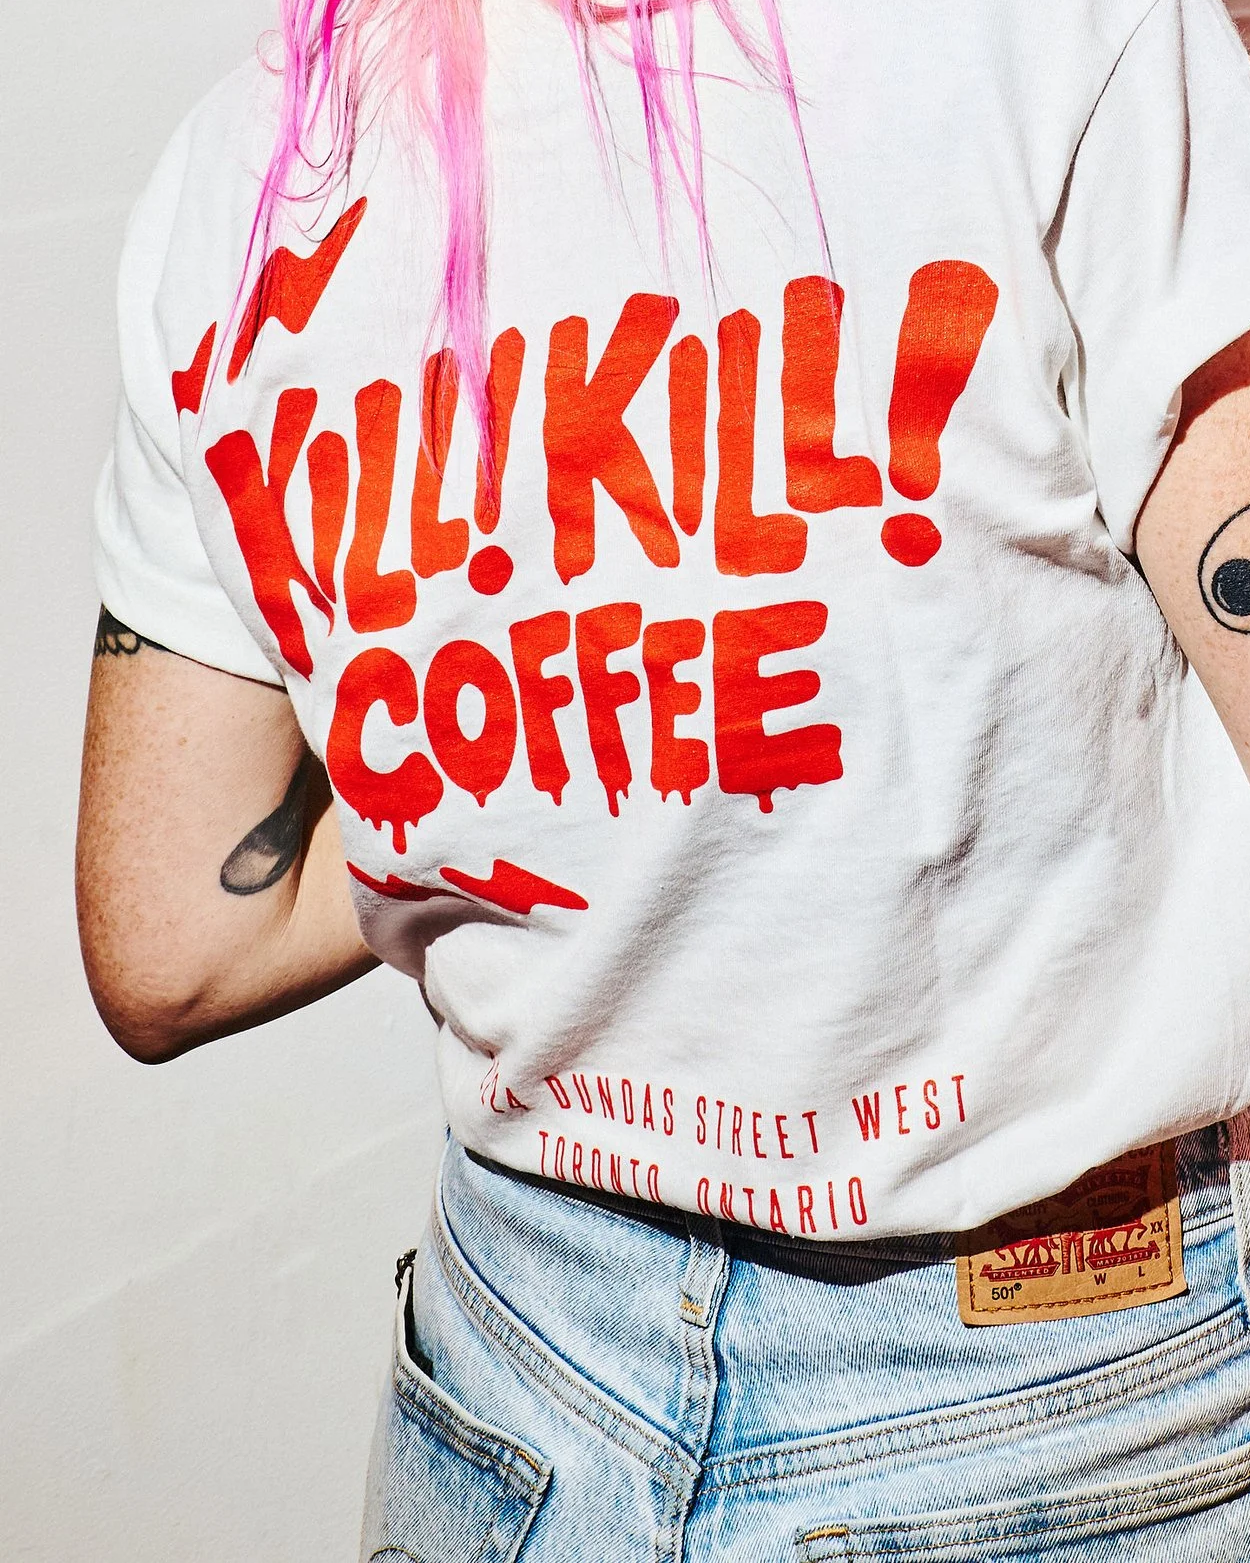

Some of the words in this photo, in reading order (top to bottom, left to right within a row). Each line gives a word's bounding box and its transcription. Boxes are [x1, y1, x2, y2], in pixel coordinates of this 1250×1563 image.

[205, 326, 525, 681] KILL!
[543, 259, 1000, 586] KILL!
[325, 599, 845, 856] COFFEE
[544, 1073, 674, 1136] DUNDAS
[696, 1095, 819, 1159] STREET
[851, 1074, 966, 1142] WEST
[538, 1130, 664, 1203] TORONTO
[696, 1176, 868, 1234] ONTARIO
[1149, 1220, 1165, 1235] XX
[992, 1267, 1050, 1278] PATENTED
[1093, 1272, 1107, 1286] W
[1137, 1265, 1146, 1278] L
[1095, 1257, 1115, 1267] MAY
